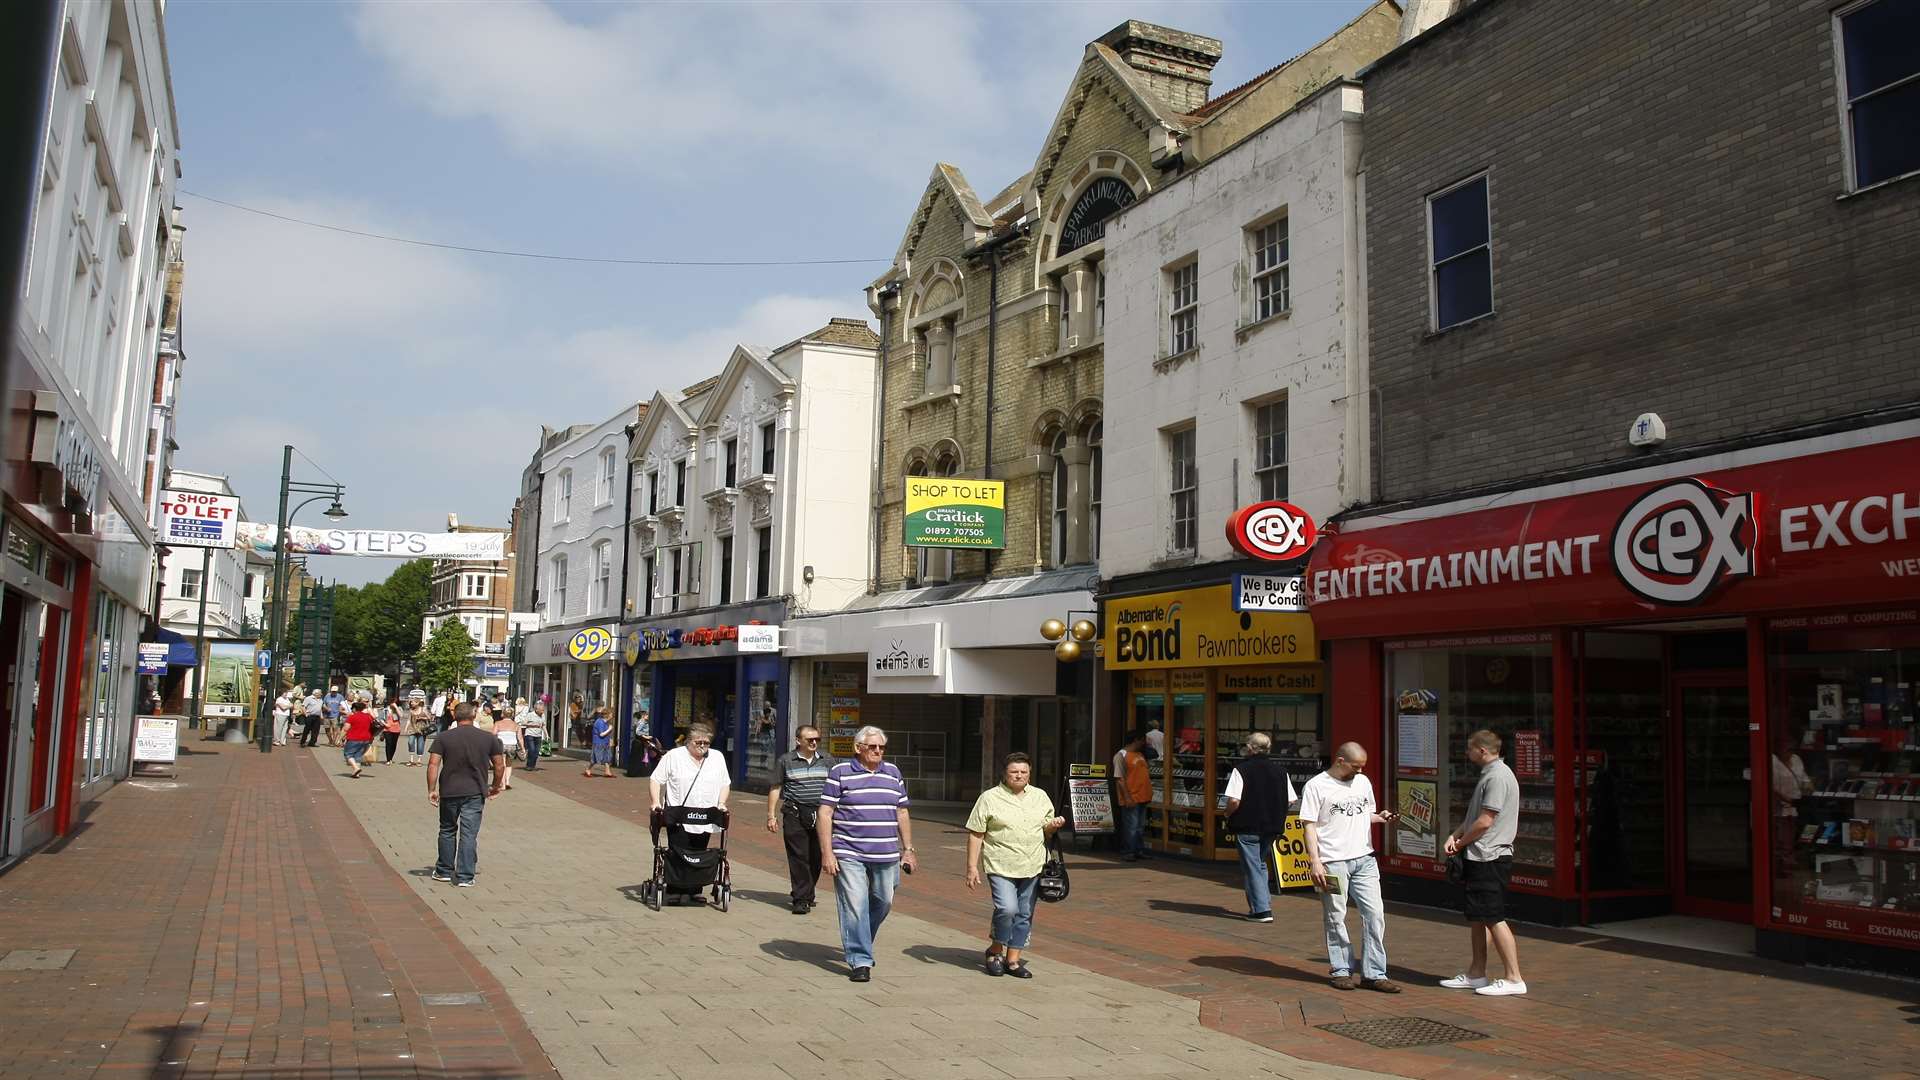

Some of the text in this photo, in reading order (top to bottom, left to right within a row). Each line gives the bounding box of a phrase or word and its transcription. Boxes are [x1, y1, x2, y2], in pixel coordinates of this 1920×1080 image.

[912, 485, 997, 499] SHOP TO LET
[178, 494, 218, 505] SHOP
[161, 502, 233, 519] TO LET
[926, 510, 984, 523] Cradick
[1780, 493, 1920, 552] EXCH
[925, 527, 984, 536] 01892 707505
[327, 530, 427, 553] STEPS
[916, 535, 993, 545] www.cradick.co.uk
[465, 542, 500, 553] 19 July
[1314, 535, 1600, 601] ENTERTAINMENT
[1243, 578, 1260, 590] We
[1265, 580, 1286, 593] Buy
[1243, 593, 1264, 606] Any
[1117, 606, 1164, 624] Albemarle
[1813, 615, 1848, 624] VISION
[1854, 611, 1917, 622] COMPUTING
[743, 635, 773, 643] adams
[1117, 619, 1180, 662] Bond
[1198, 630, 1296, 658] Pawnbrokers
[876, 655, 929, 670] adams kids
[1225, 674, 1315, 688] Instant Cash!
[1515, 732, 1539, 742] Opening
[687, 812, 708, 820] drive
[1411, 803, 1431, 823] ONE
[1511, 875, 1549, 888] RECYCLING
[1788, 913, 1808, 924] BUY
[1826, 919, 1849, 930] SELL
